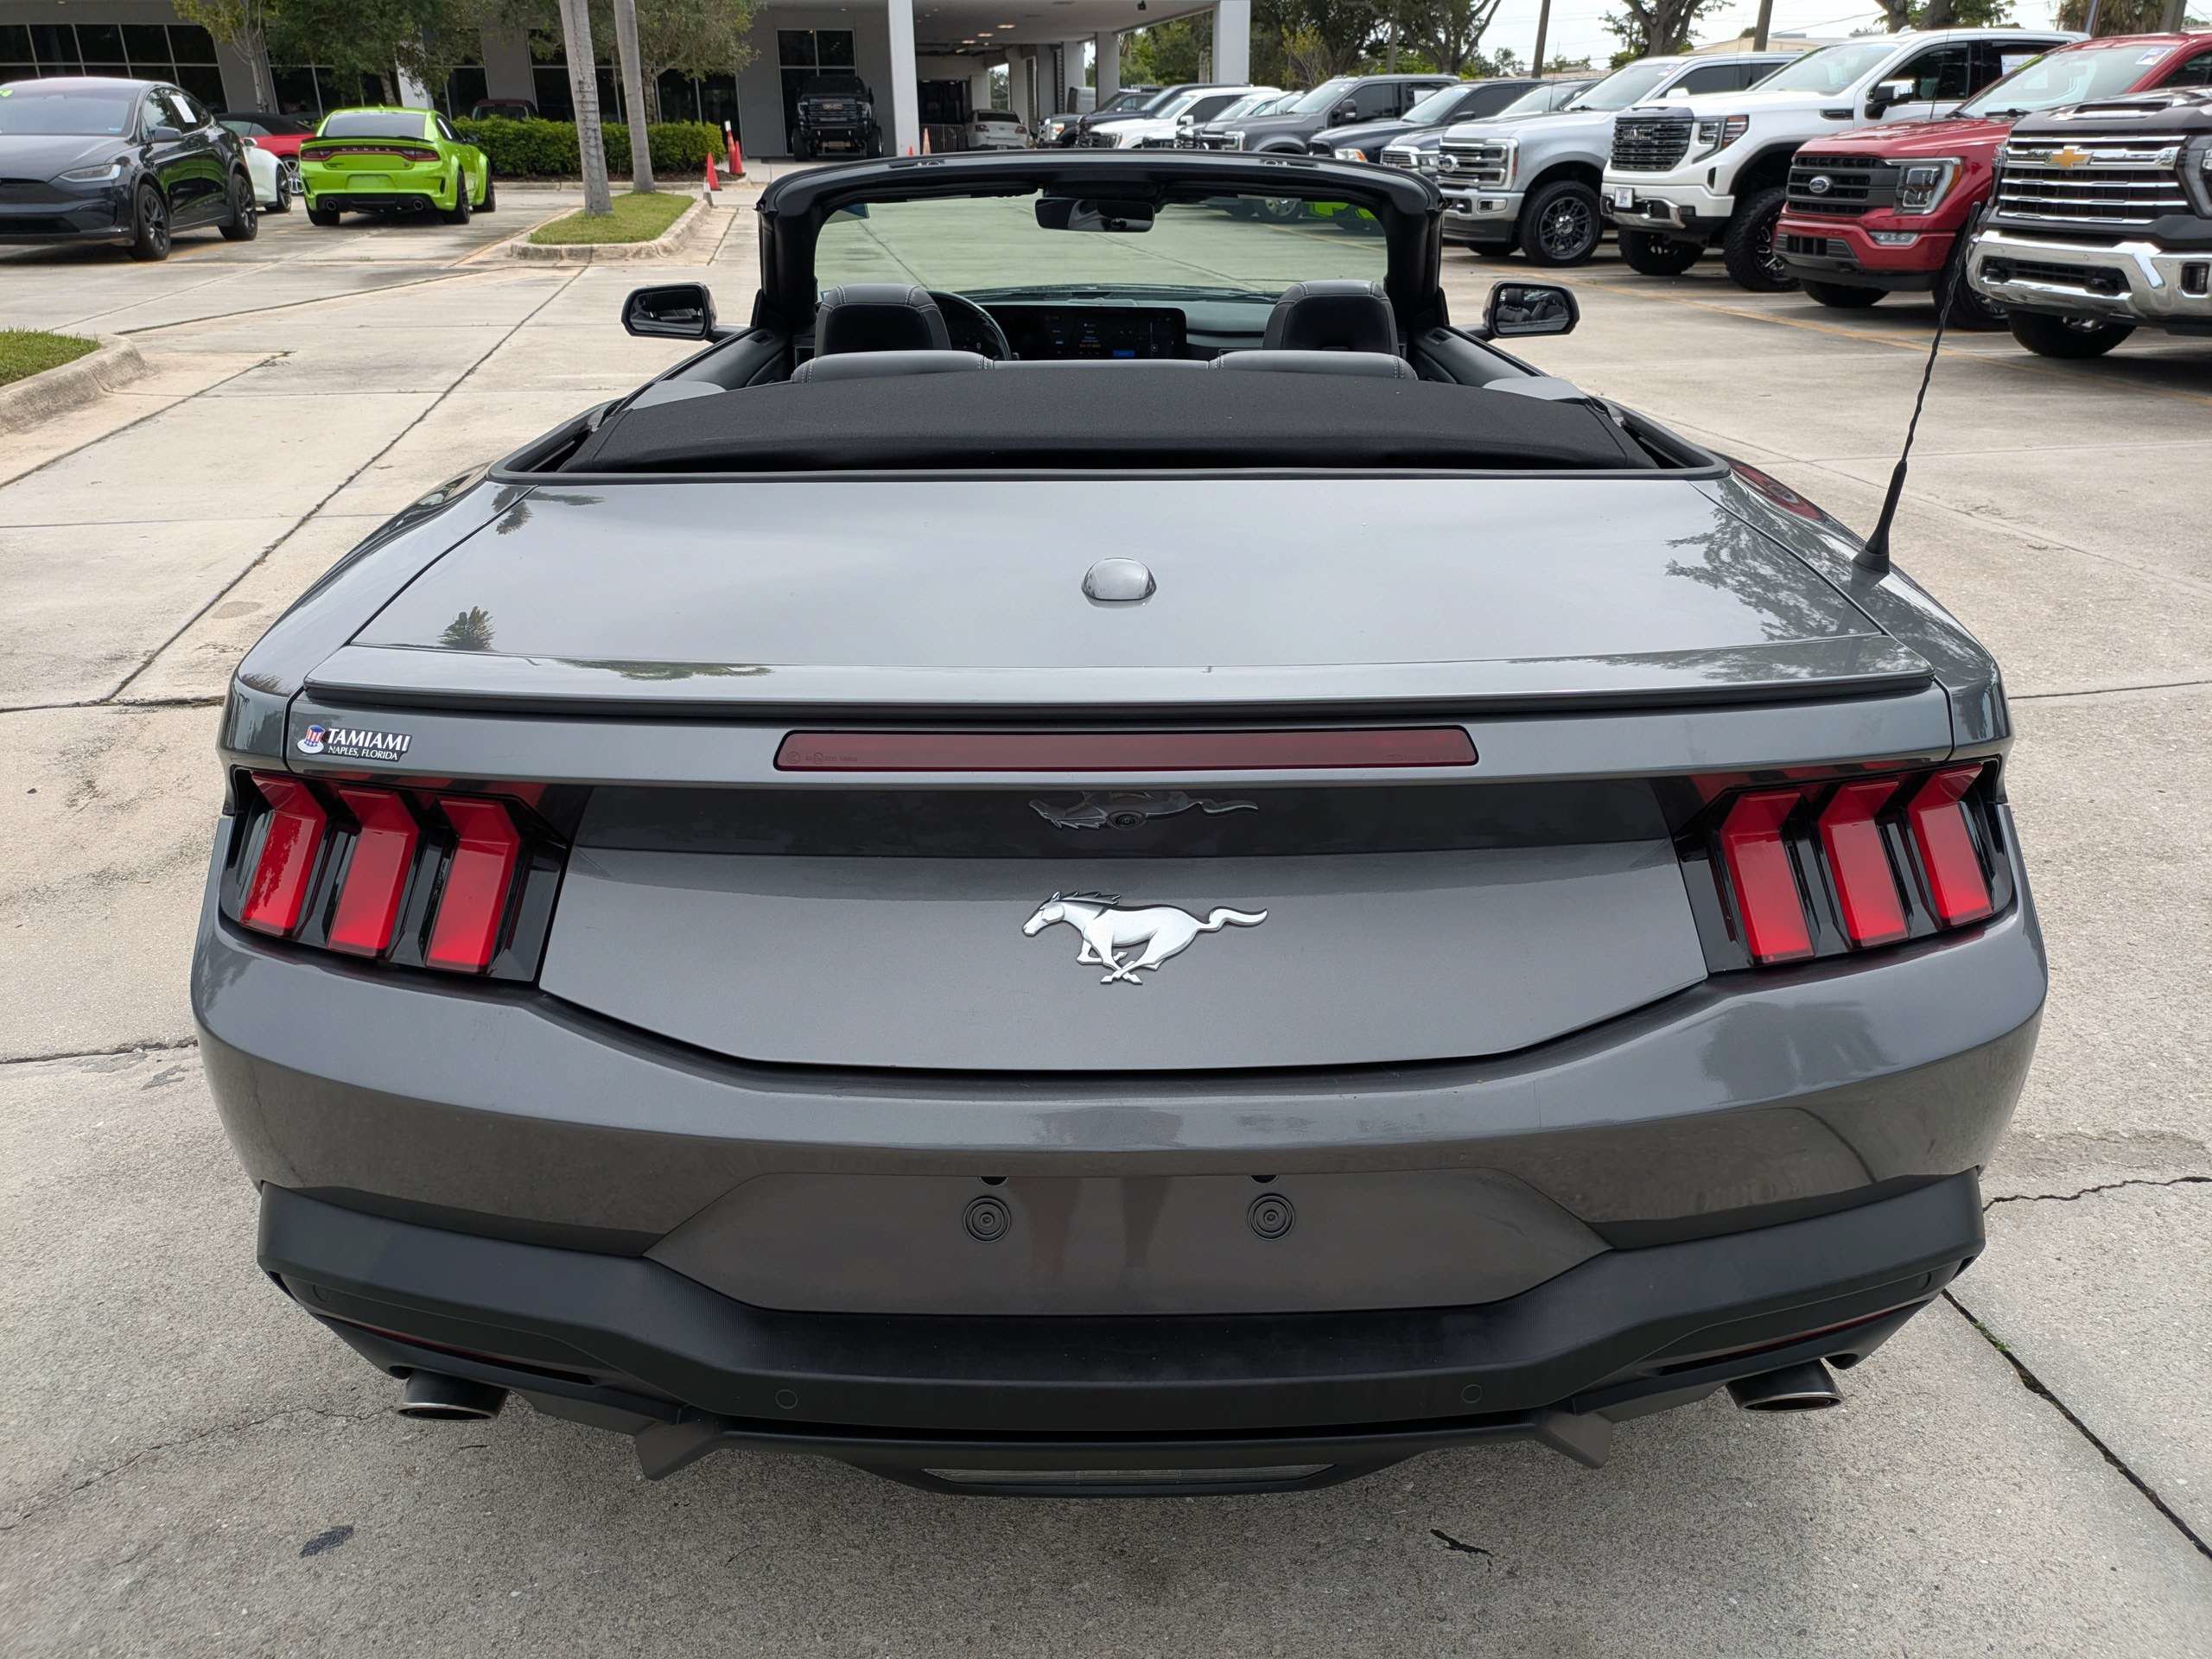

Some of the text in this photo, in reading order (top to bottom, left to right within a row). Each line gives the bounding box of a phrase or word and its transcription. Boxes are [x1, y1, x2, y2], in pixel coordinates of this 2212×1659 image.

[327, 728, 410, 752] TAMIAMI
[328, 746, 398, 760] NAPLES, FLORIDA
